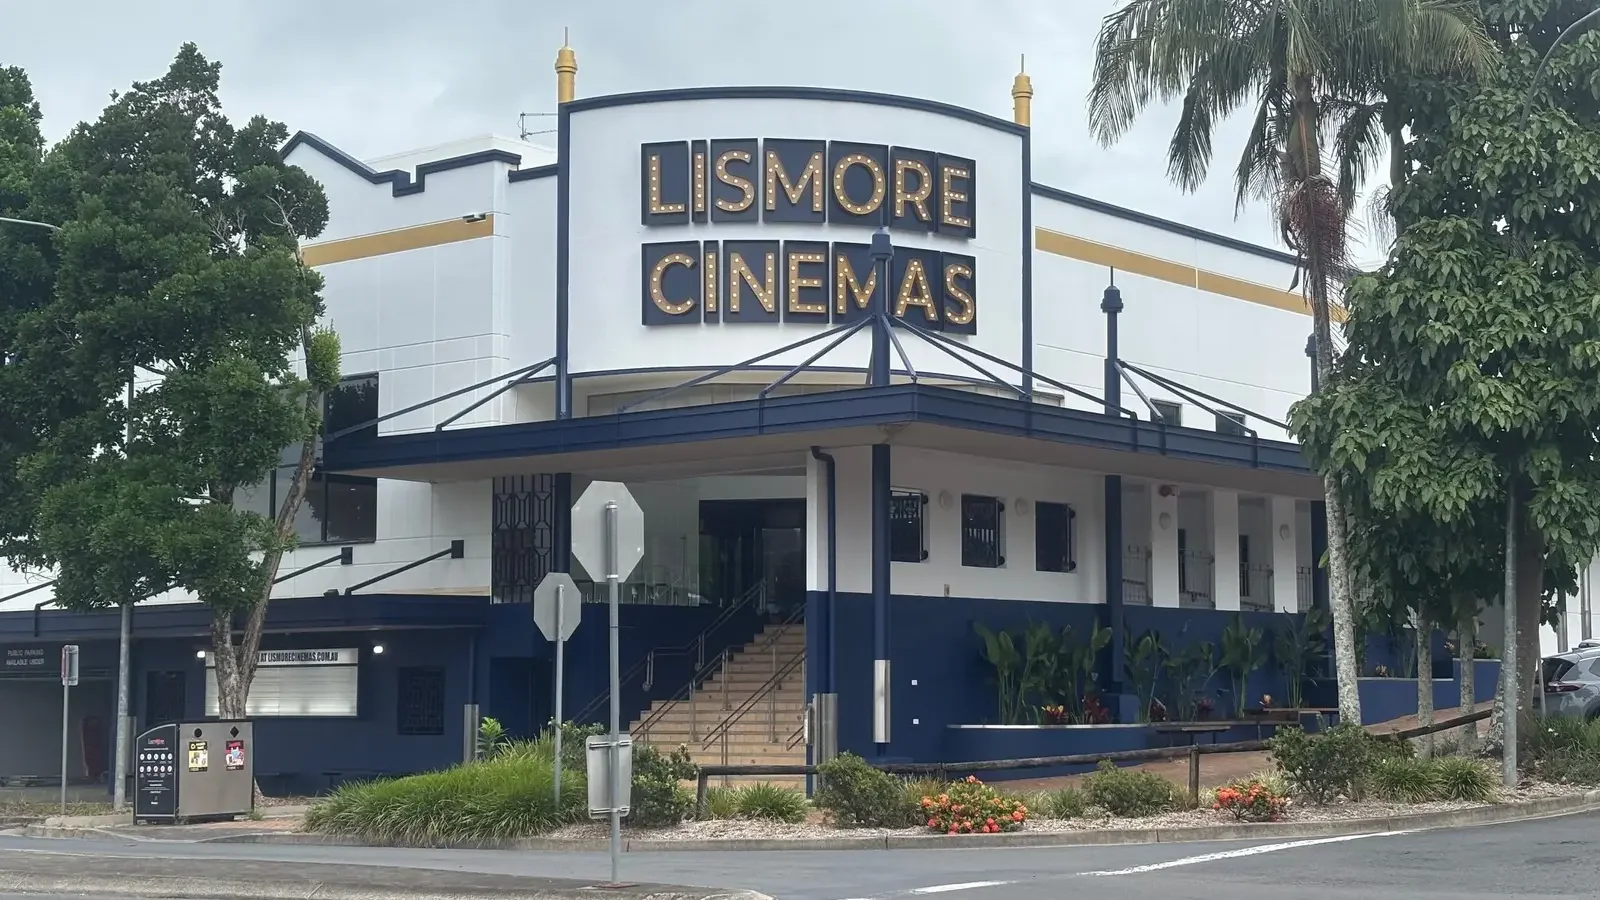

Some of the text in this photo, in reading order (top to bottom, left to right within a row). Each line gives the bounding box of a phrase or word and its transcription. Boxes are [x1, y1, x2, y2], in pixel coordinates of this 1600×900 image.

[649, 150, 972, 229] LISMORE
[650, 252, 976, 325] CINEMAS
[268, 652, 338, 662] LISMORECINEMAS.COM.AU
